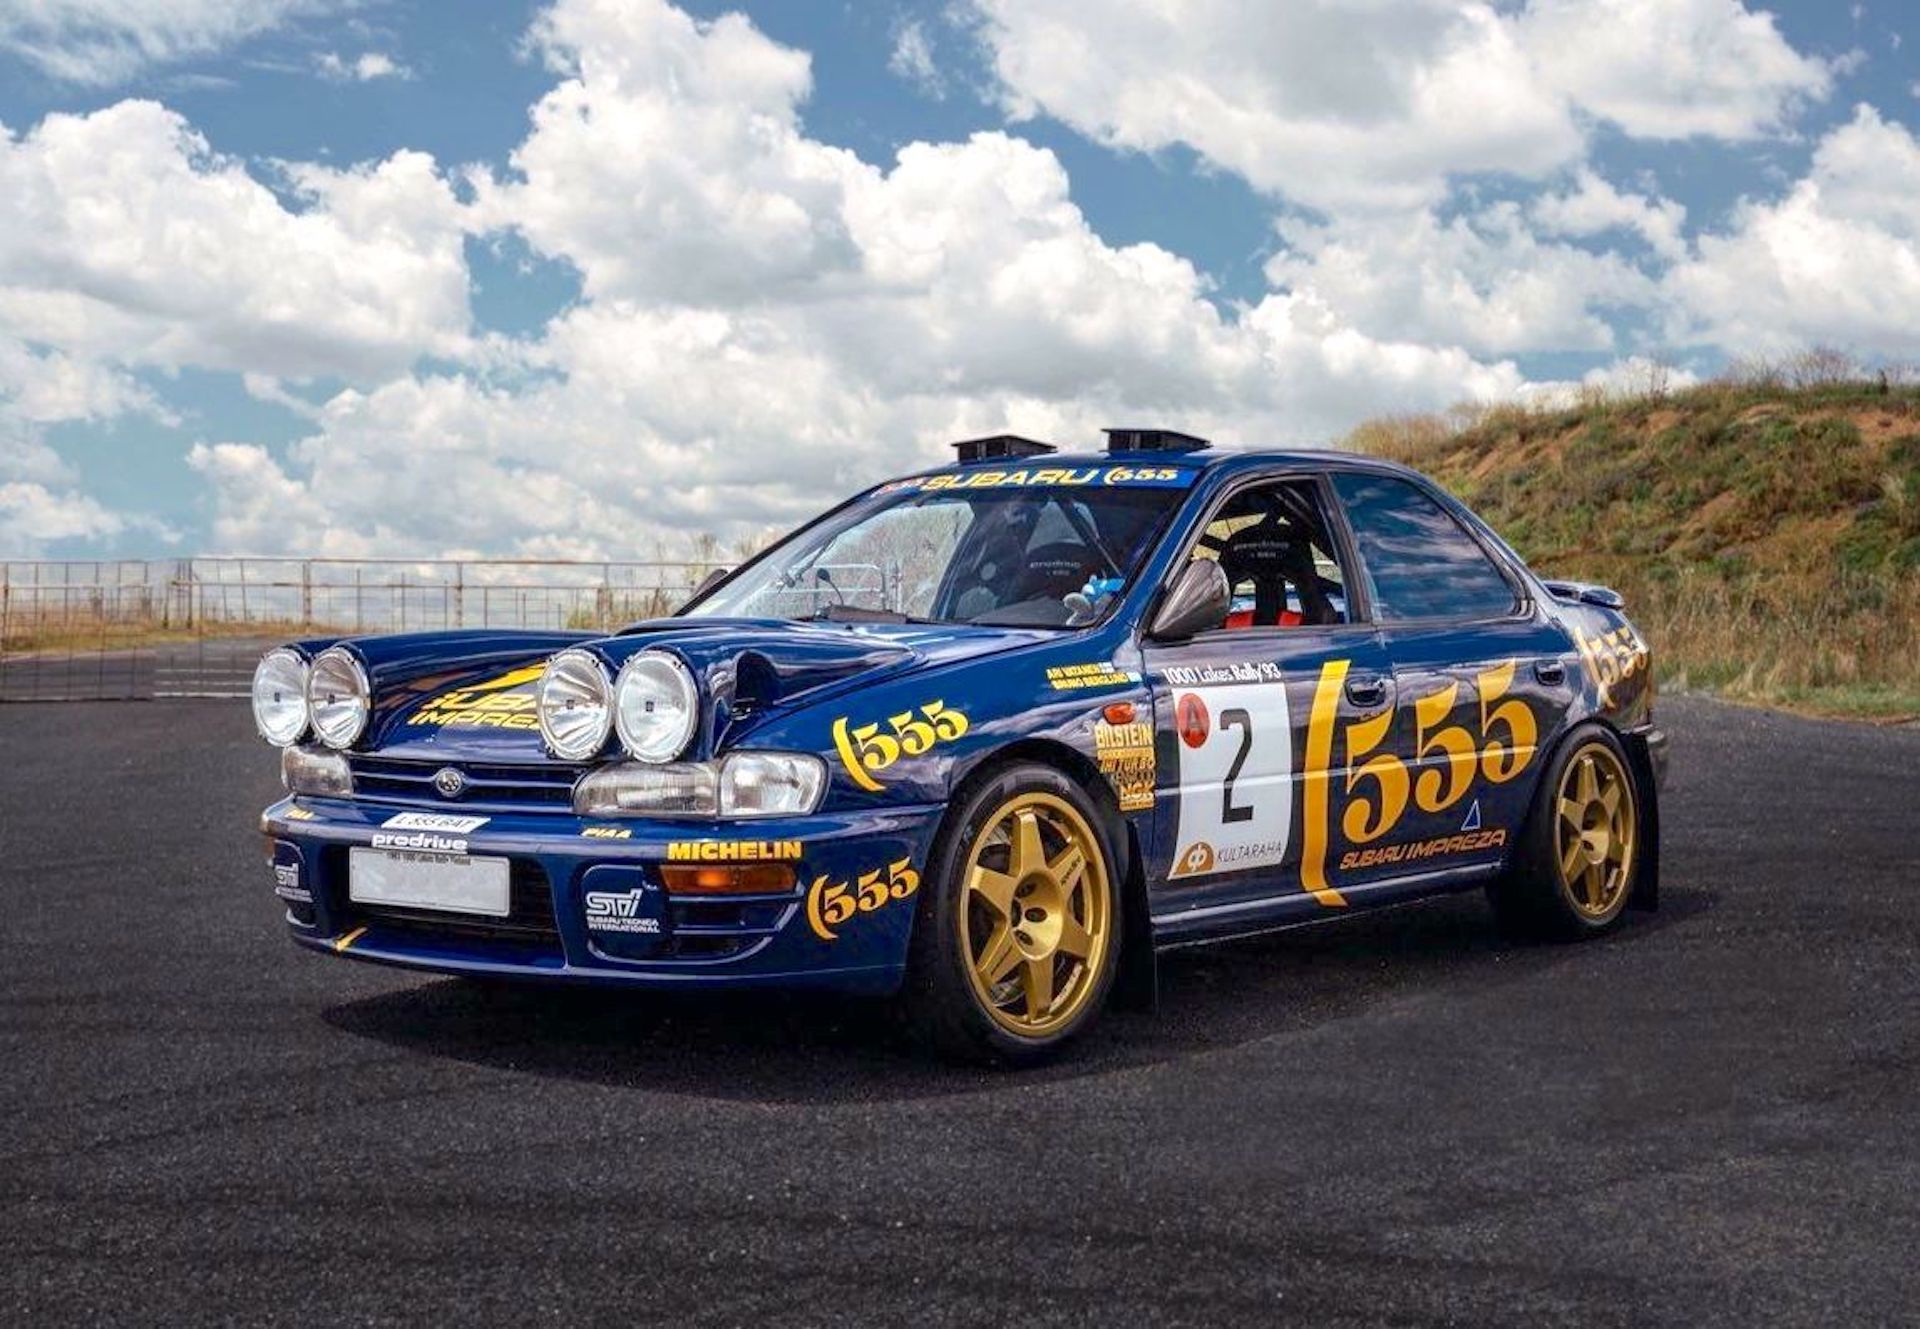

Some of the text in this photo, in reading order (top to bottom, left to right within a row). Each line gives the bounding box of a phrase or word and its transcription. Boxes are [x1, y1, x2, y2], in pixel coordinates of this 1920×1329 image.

[920, 469, 1099, 491] SUBARU
[1162, 667, 1198, 685] 1000
[1195, 664, 1234, 683] Lakes
[1184, 702, 1206, 738] A
[1095, 723, 1153, 748] BILSTEIN
[1220, 708, 1254, 824] 2
[372, 832, 468, 850] prodrive
[581, 827, 632, 840] PIAA
[667, 841, 802, 860] MICHELIN
[1217, 840, 1282, 863] KULTARAHA
[1340, 829, 1507, 870] SUBARU IMPREZA
[586, 915, 621, 925] SUBARU
[588, 922, 661, 934] INTERNATIONAL
